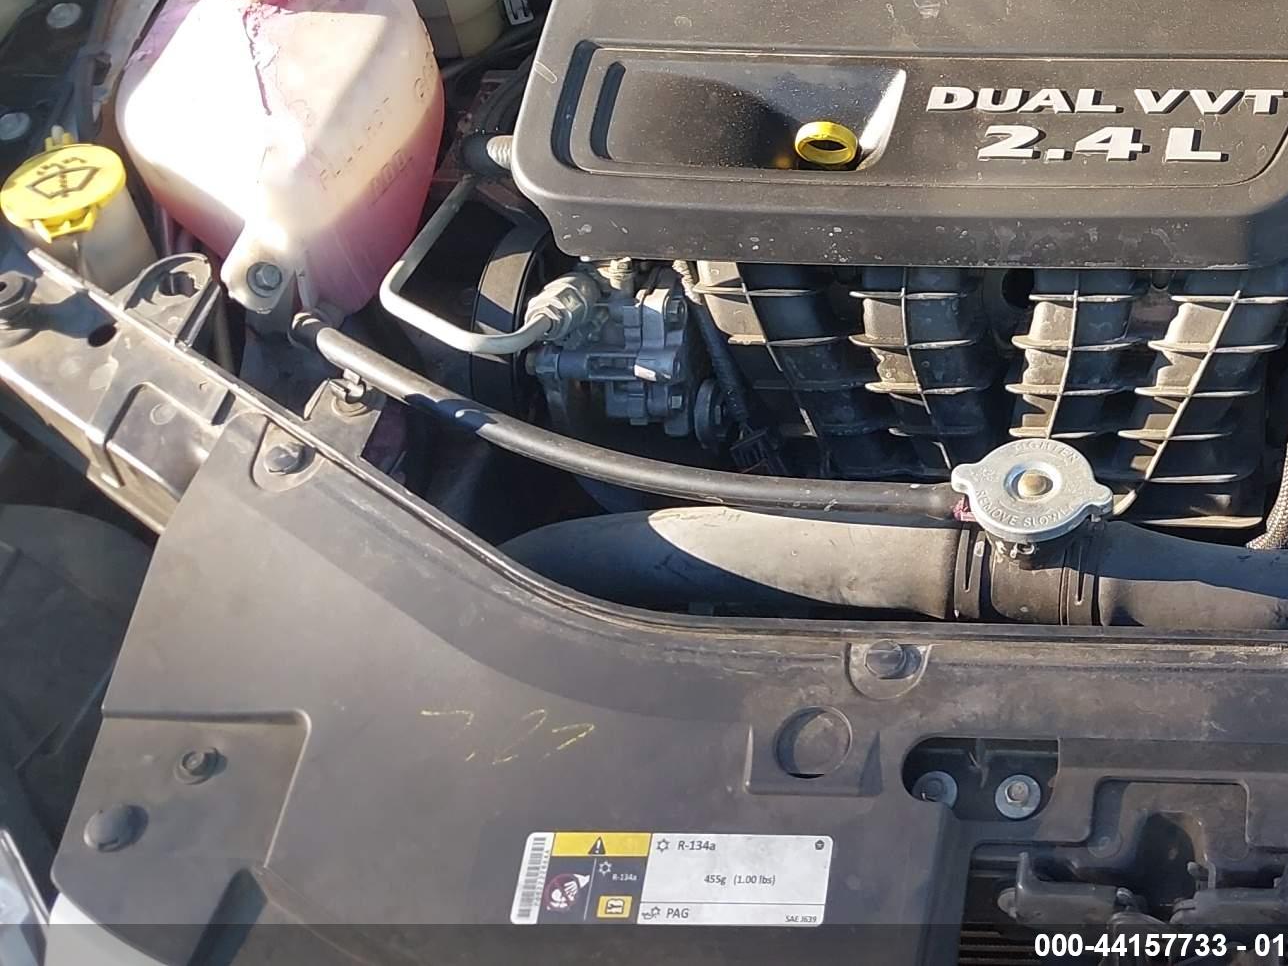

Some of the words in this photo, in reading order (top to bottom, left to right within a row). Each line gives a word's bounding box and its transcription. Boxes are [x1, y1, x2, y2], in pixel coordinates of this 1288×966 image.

[926, 85, 1122, 113] DUAL
[978, 124, 1151, 162] 2.4
[1163, 127, 1229, 163] L
[1014, 441, 1080, 464] TIGHTEN
[975, 490, 1019, 526] REMOVE
[1023, 503, 1074, 527] SLOWLY
[677, 840, 716, 851] R-134a
[703, 875, 727, 886] 455g
[733, 875, 758, 886] (1.00
[759, 875, 776, 886] lbs)
[666, 908, 690, 919] PAG
[785, 915, 799, 923] SAE
